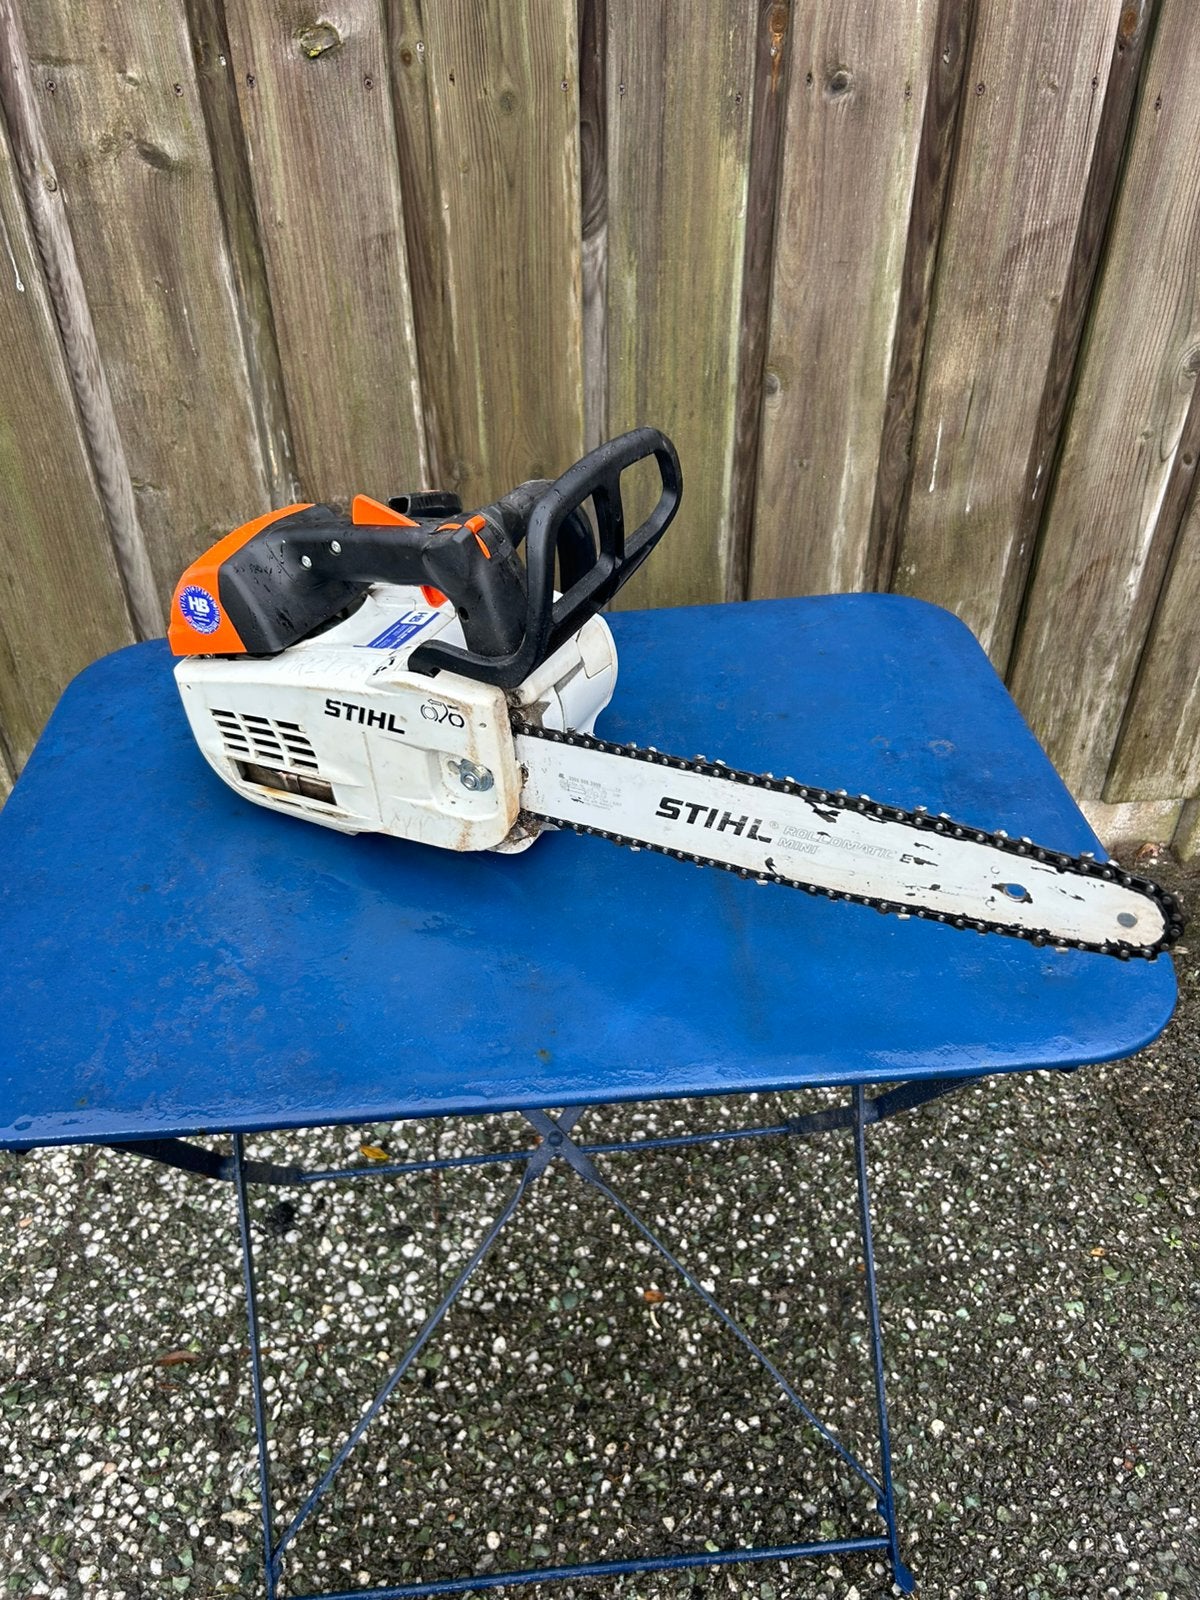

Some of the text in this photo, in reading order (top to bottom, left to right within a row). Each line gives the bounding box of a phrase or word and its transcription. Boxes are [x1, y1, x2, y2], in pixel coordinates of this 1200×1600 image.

[187, 595, 210, 613] HB
[324, 698, 405, 735] STIHL
[655, 796, 772, 844] STIHL
[777, 837, 819, 855] MINI
[783, 825, 895, 858] ROLLOMATIC
